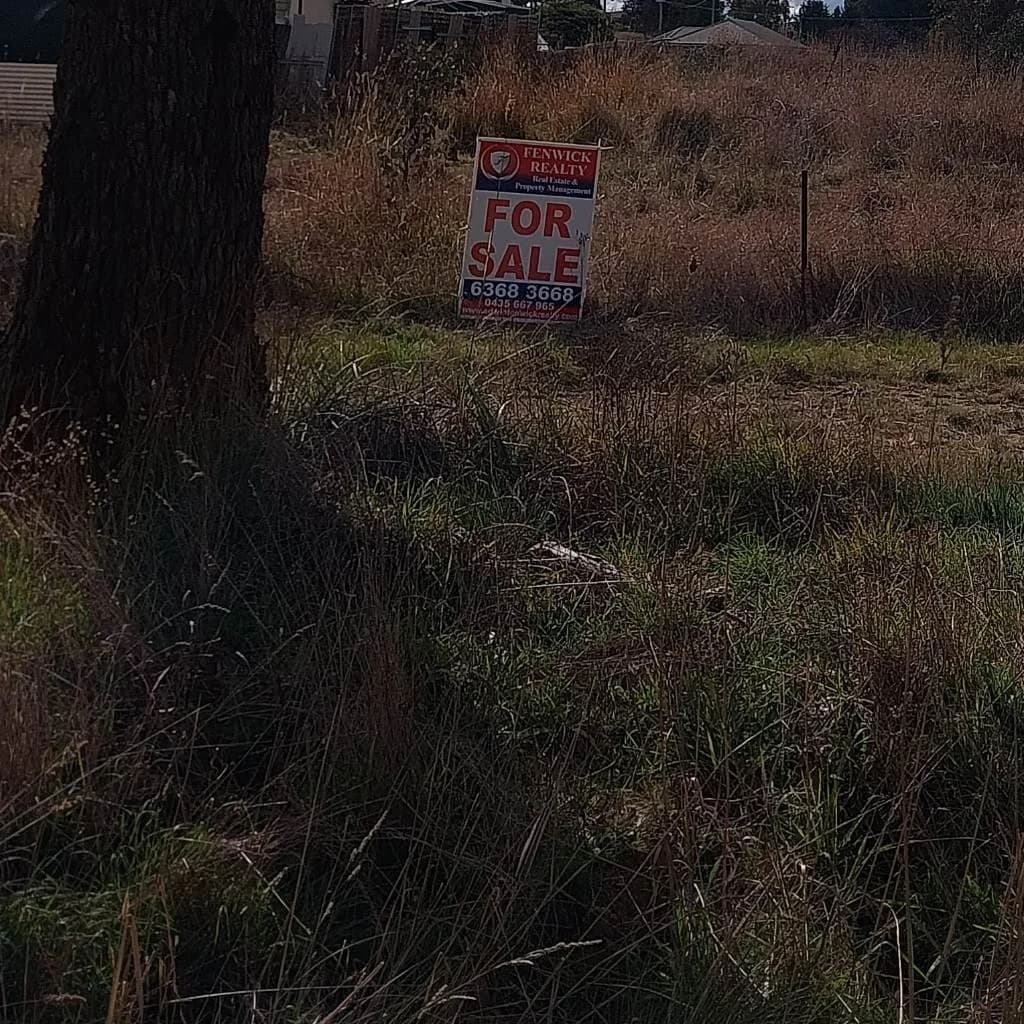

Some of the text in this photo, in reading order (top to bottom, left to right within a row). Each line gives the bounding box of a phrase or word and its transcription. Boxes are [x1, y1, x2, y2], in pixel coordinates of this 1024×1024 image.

[523, 147, 592, 163] FENWICK
[530, 161, 588, 176] REALTY
[532, 175, 549, 183] Real
[549, 176, 571, 185] Estate
[515, 182, 592, 195] Property Management
[484, 197, 573, 239] FOR
[467, 241, 581, 284] SALE
[470, 281, 574, 302] 6368 3668
